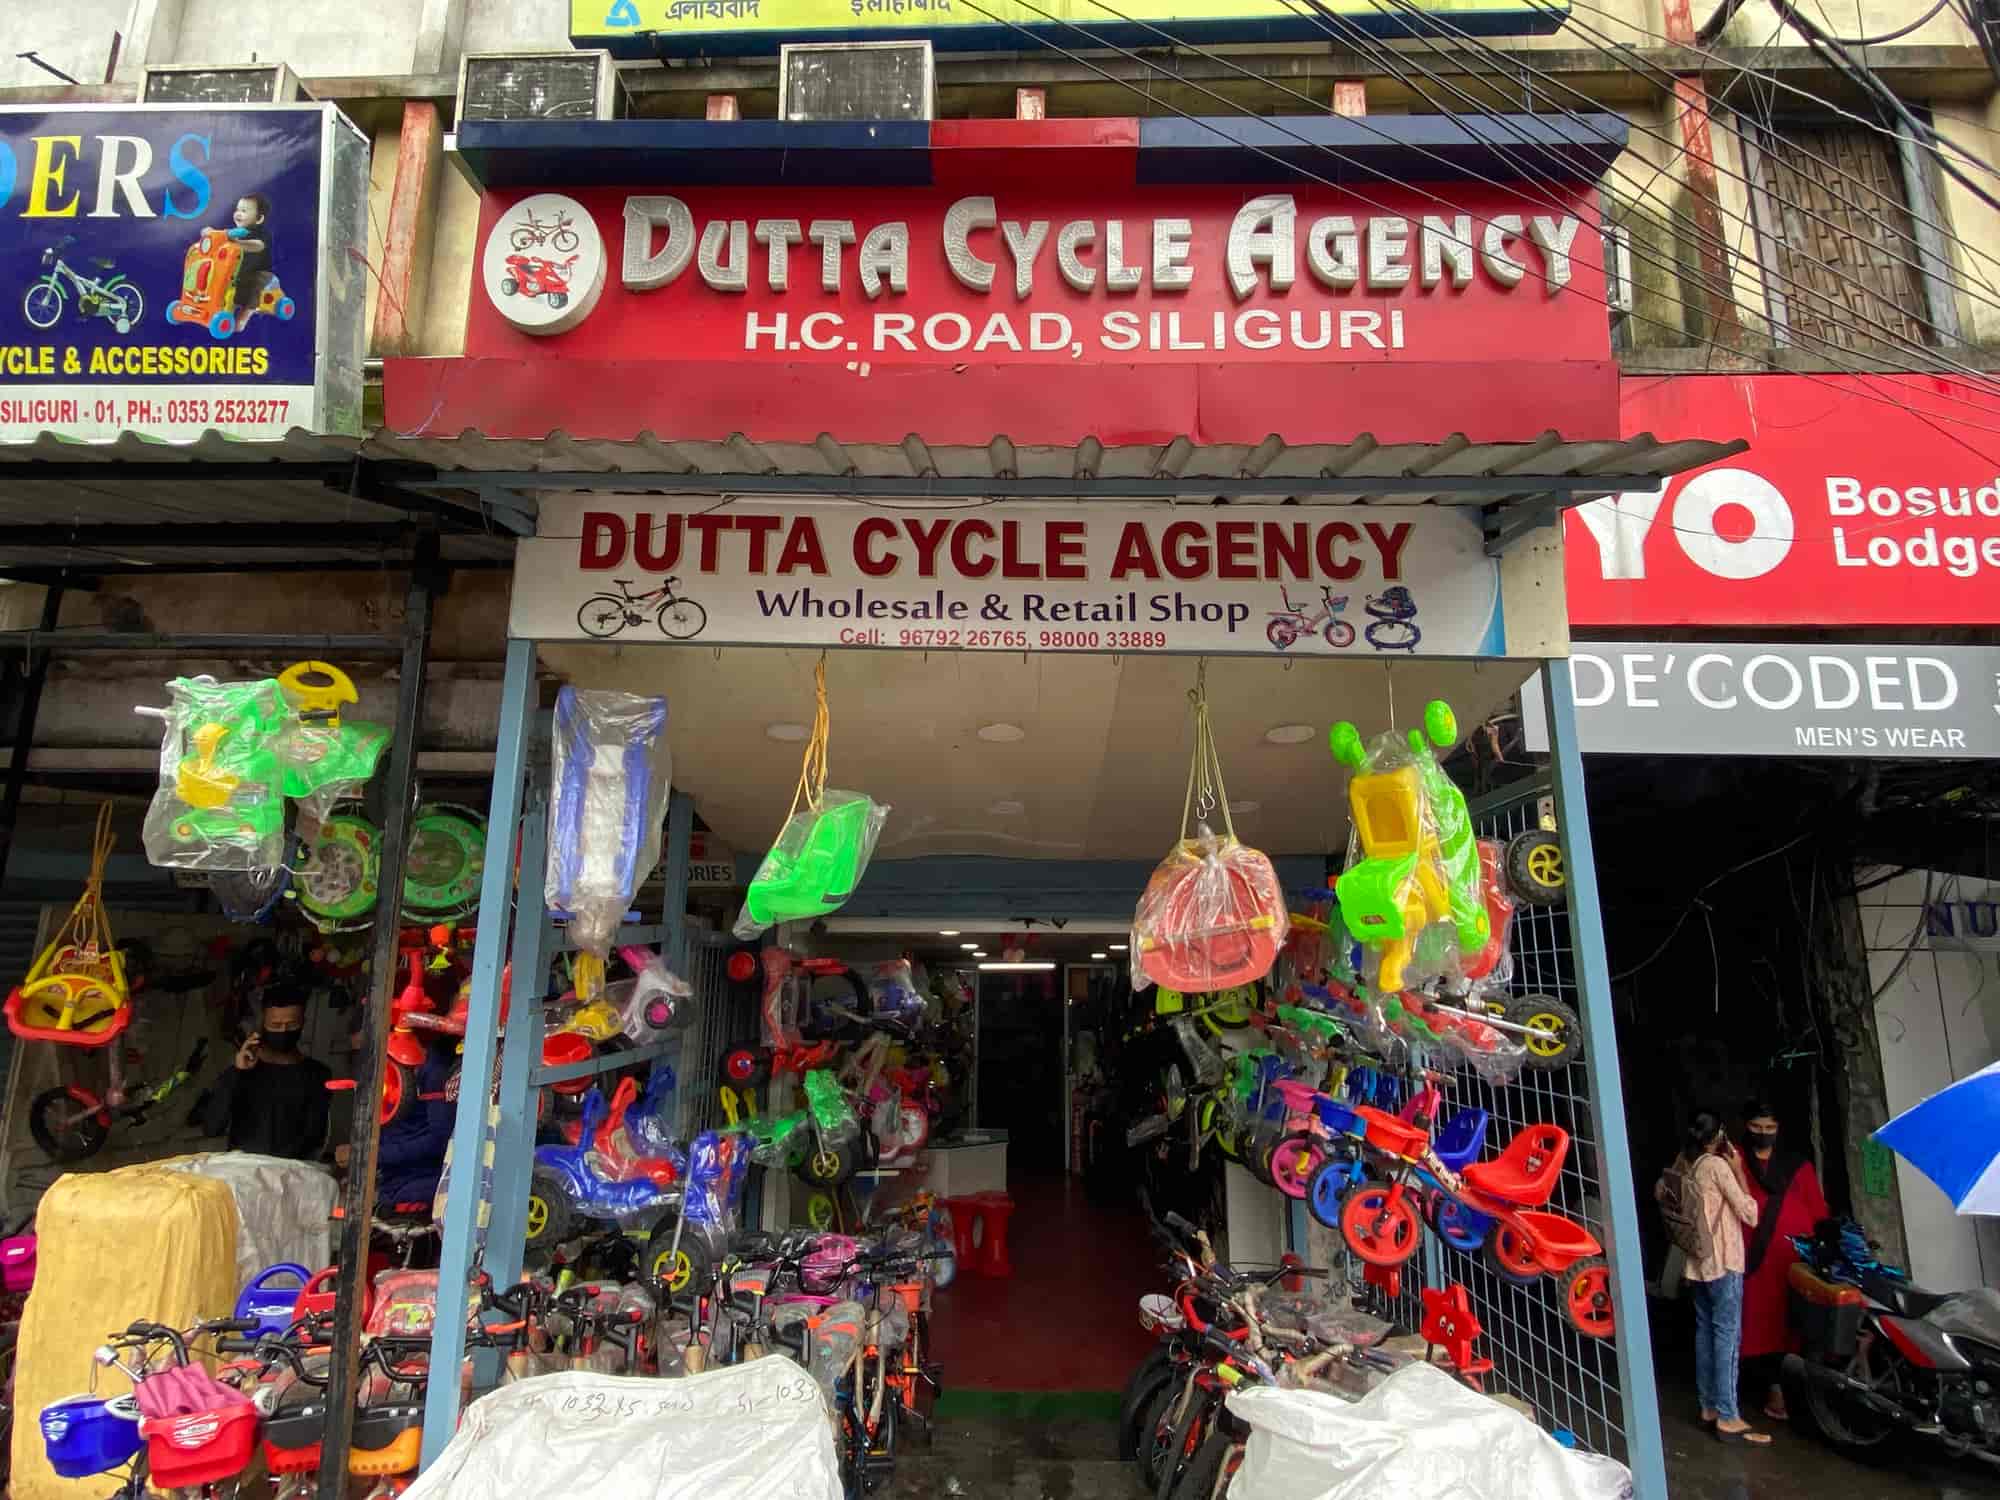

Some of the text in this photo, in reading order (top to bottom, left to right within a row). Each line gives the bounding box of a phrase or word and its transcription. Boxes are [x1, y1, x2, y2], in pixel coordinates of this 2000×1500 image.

[0, 133, 213, 221] ERS
[745, 309, 1405, 358] H.C. ROAD, SILIGURI
[63, 346, 82, 374] &
[89, 346, 269, 375] ACCESSORIES
[0, 400, 79, 423] SILIGURI
[95, 400, 121, 428] 01,
[127, 400, 162, 423] PH.:
[168, 400, 209, 423] 0353
[214, 400, 288, 423] 2523277
[579, 511, 1417, 582] DUTTA CYCLE AGENCY
[756, 587, 1250, 632] Wholesale & Retail Shop
[839, 627, 1168, 649] Cell: 96792 26765, 98000 33889
[1884, 728, 1967, 748] WEAR
